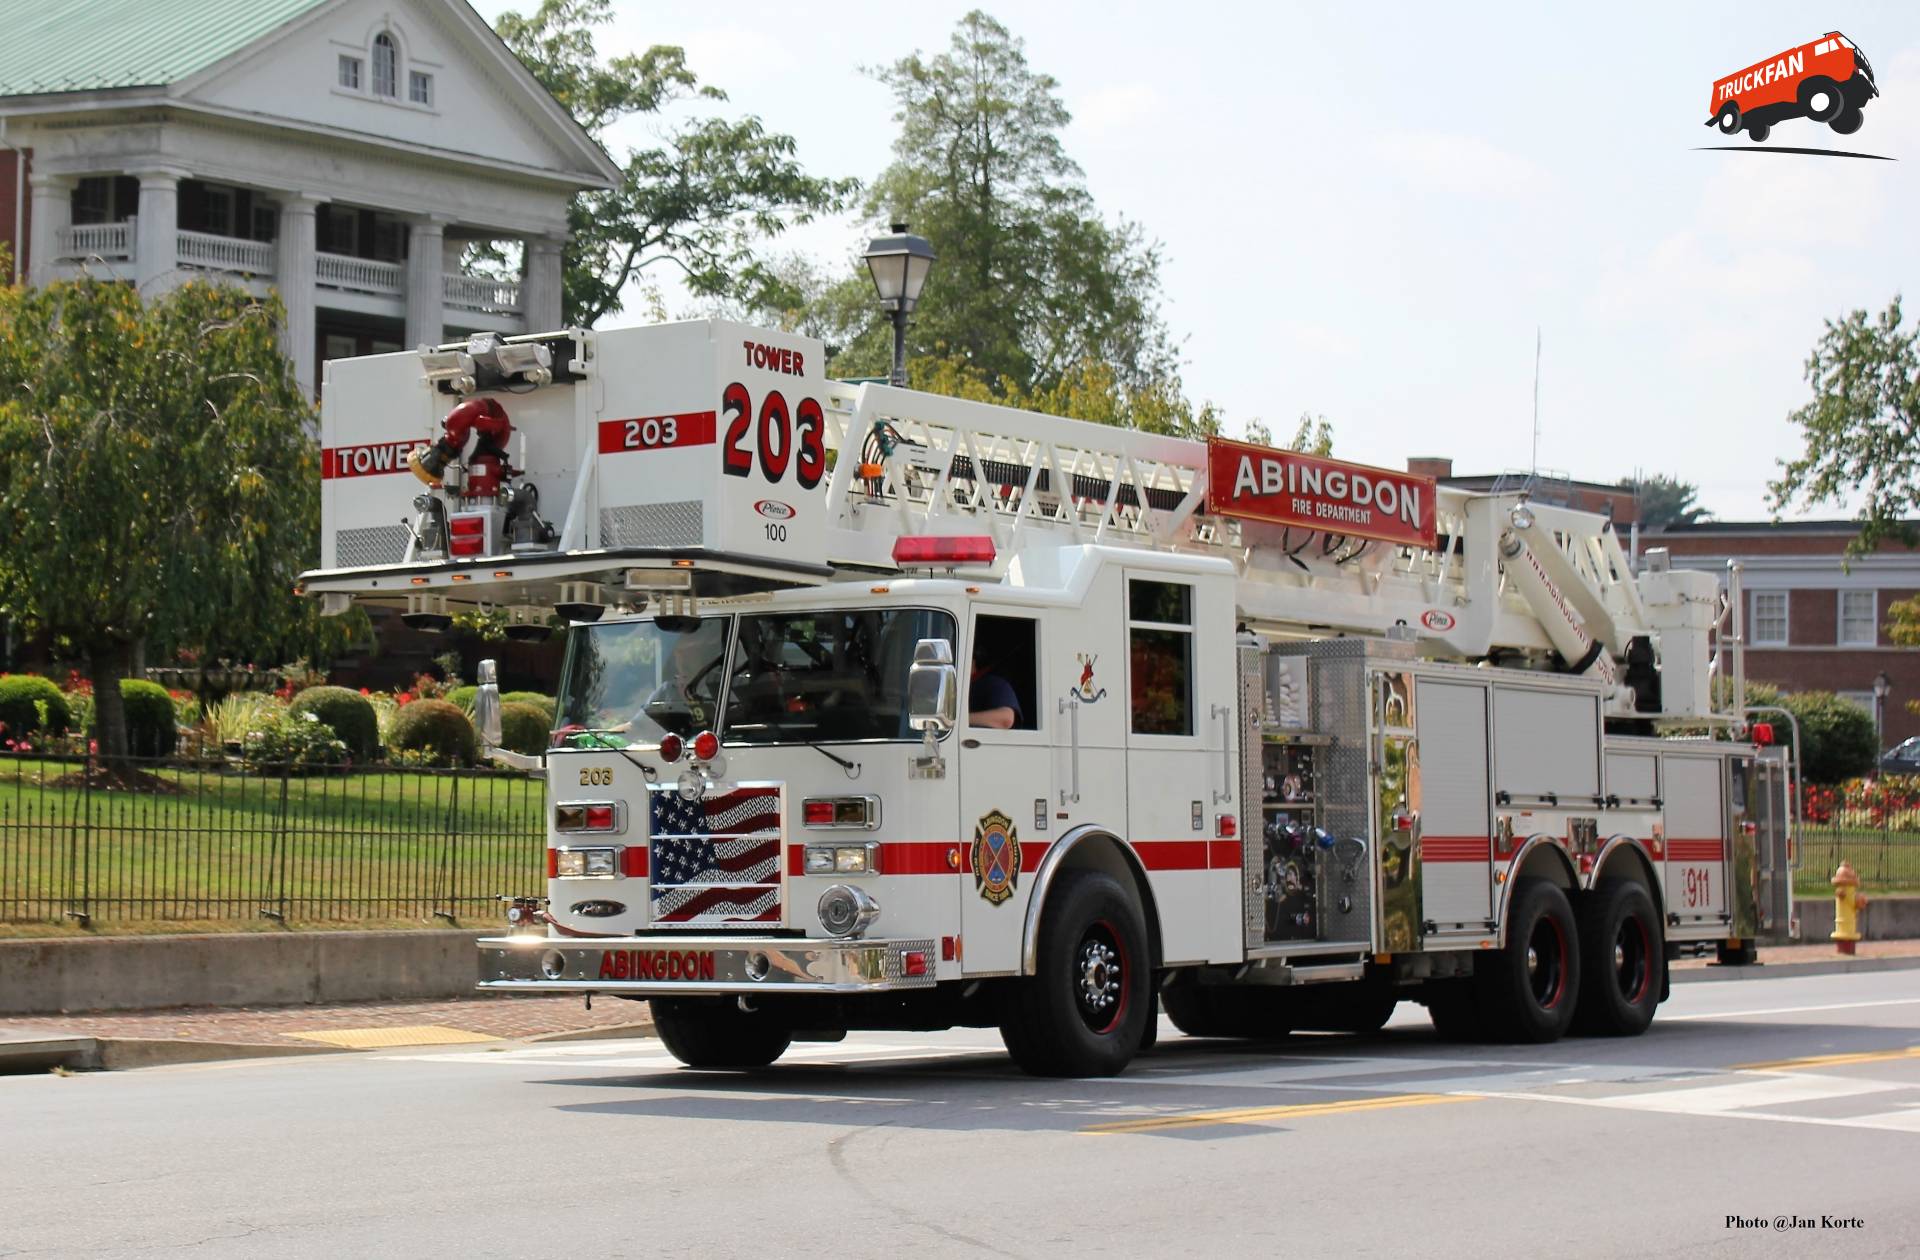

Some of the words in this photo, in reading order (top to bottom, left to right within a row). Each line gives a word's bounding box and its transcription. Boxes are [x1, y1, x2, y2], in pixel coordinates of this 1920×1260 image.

[743, 341, 804, 377] TOWER
[625, 417, 677, 447] 203
[722, 382, 825, 490] 203
[1233, 455, 1420, 530] ABINGDON
[1292, 498, 1312, 515] FIRE
[1316, 505, 1371, 524] DEPARTMENT
[765, 523, 786, 542] 100
[579, 767, 614, 785] 203
[1687, 868, 1709, 907] 911
[599, 949, 714, 979] ABINGDON
